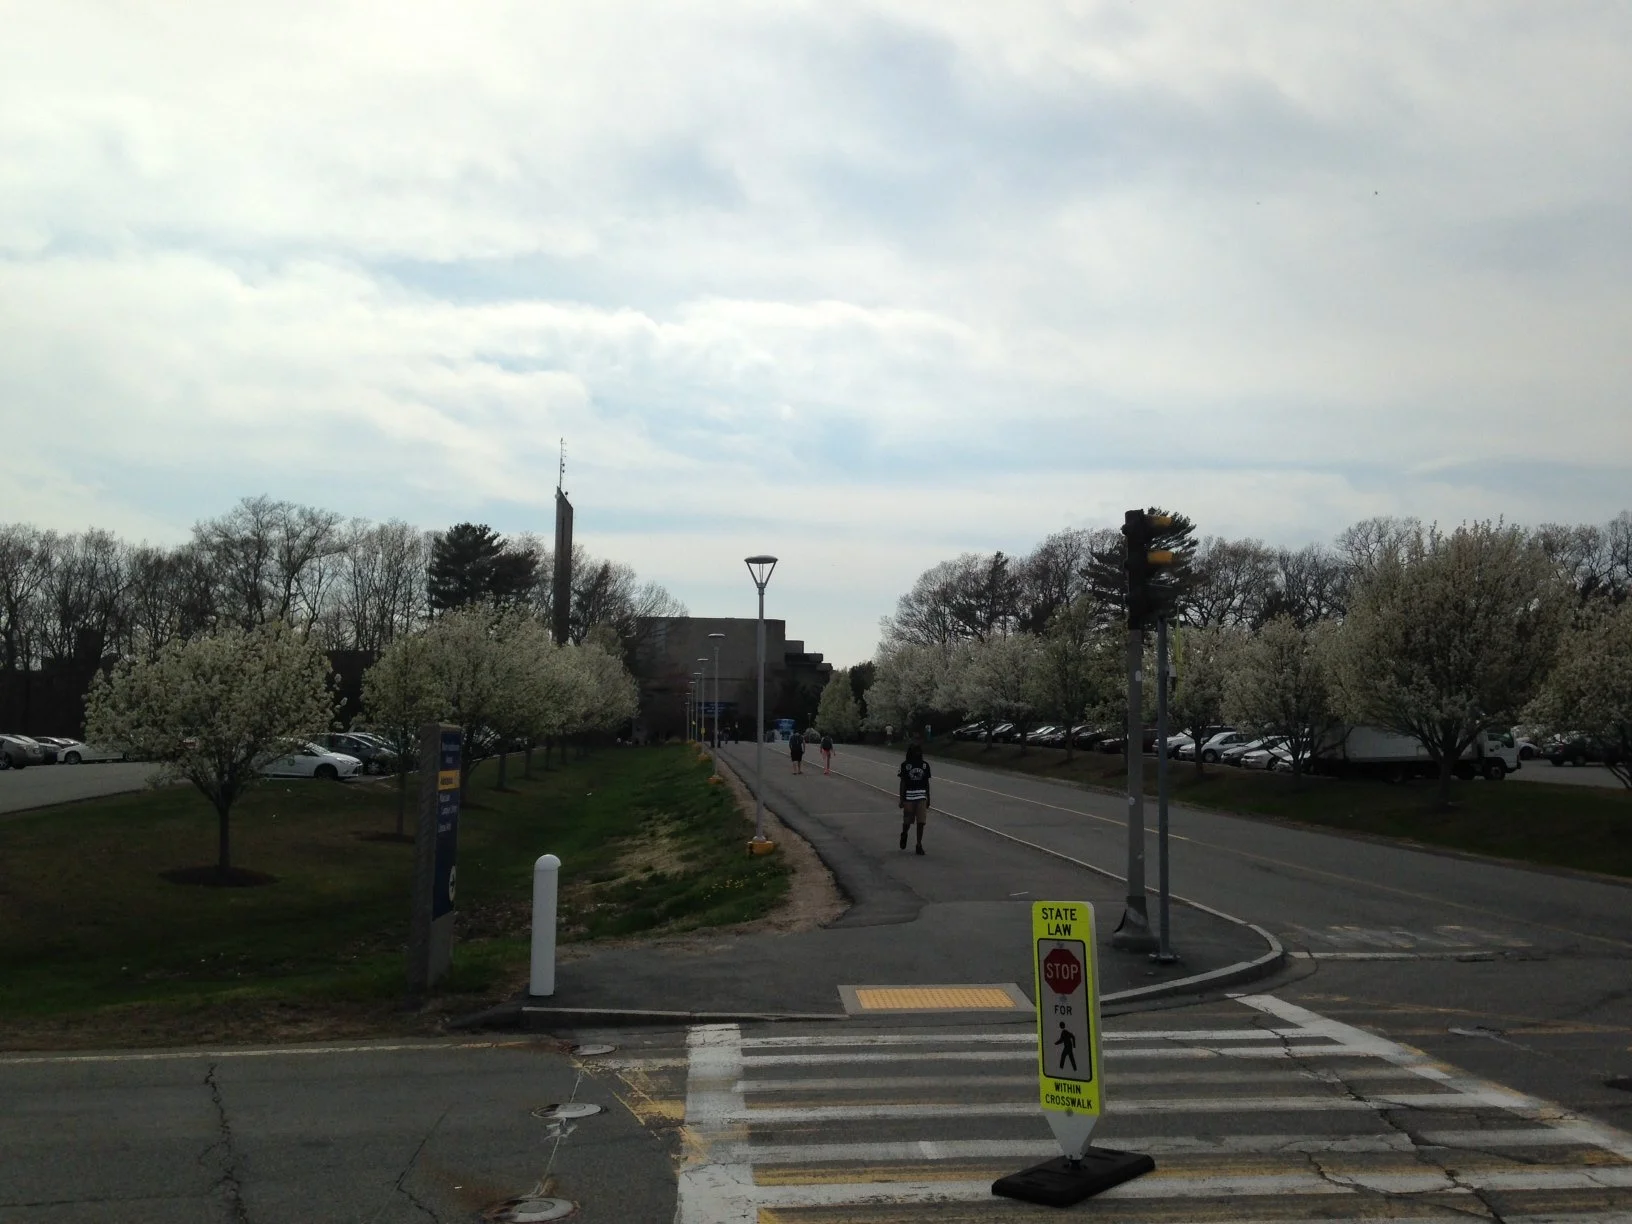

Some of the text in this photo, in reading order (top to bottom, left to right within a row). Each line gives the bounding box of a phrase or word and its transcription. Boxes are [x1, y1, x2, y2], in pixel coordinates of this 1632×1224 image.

[1041, 907, 1078, 921] STATE
[1047, 923, 1072, 936] LAW
[1046, 962, 1079, 980] STOP
[1054, 1004, 1073, 1016] FOR
[1054, 1081, 1082, 1095] WITHIN
[1045, 1093, 1093, 1110] CROSSWALK
